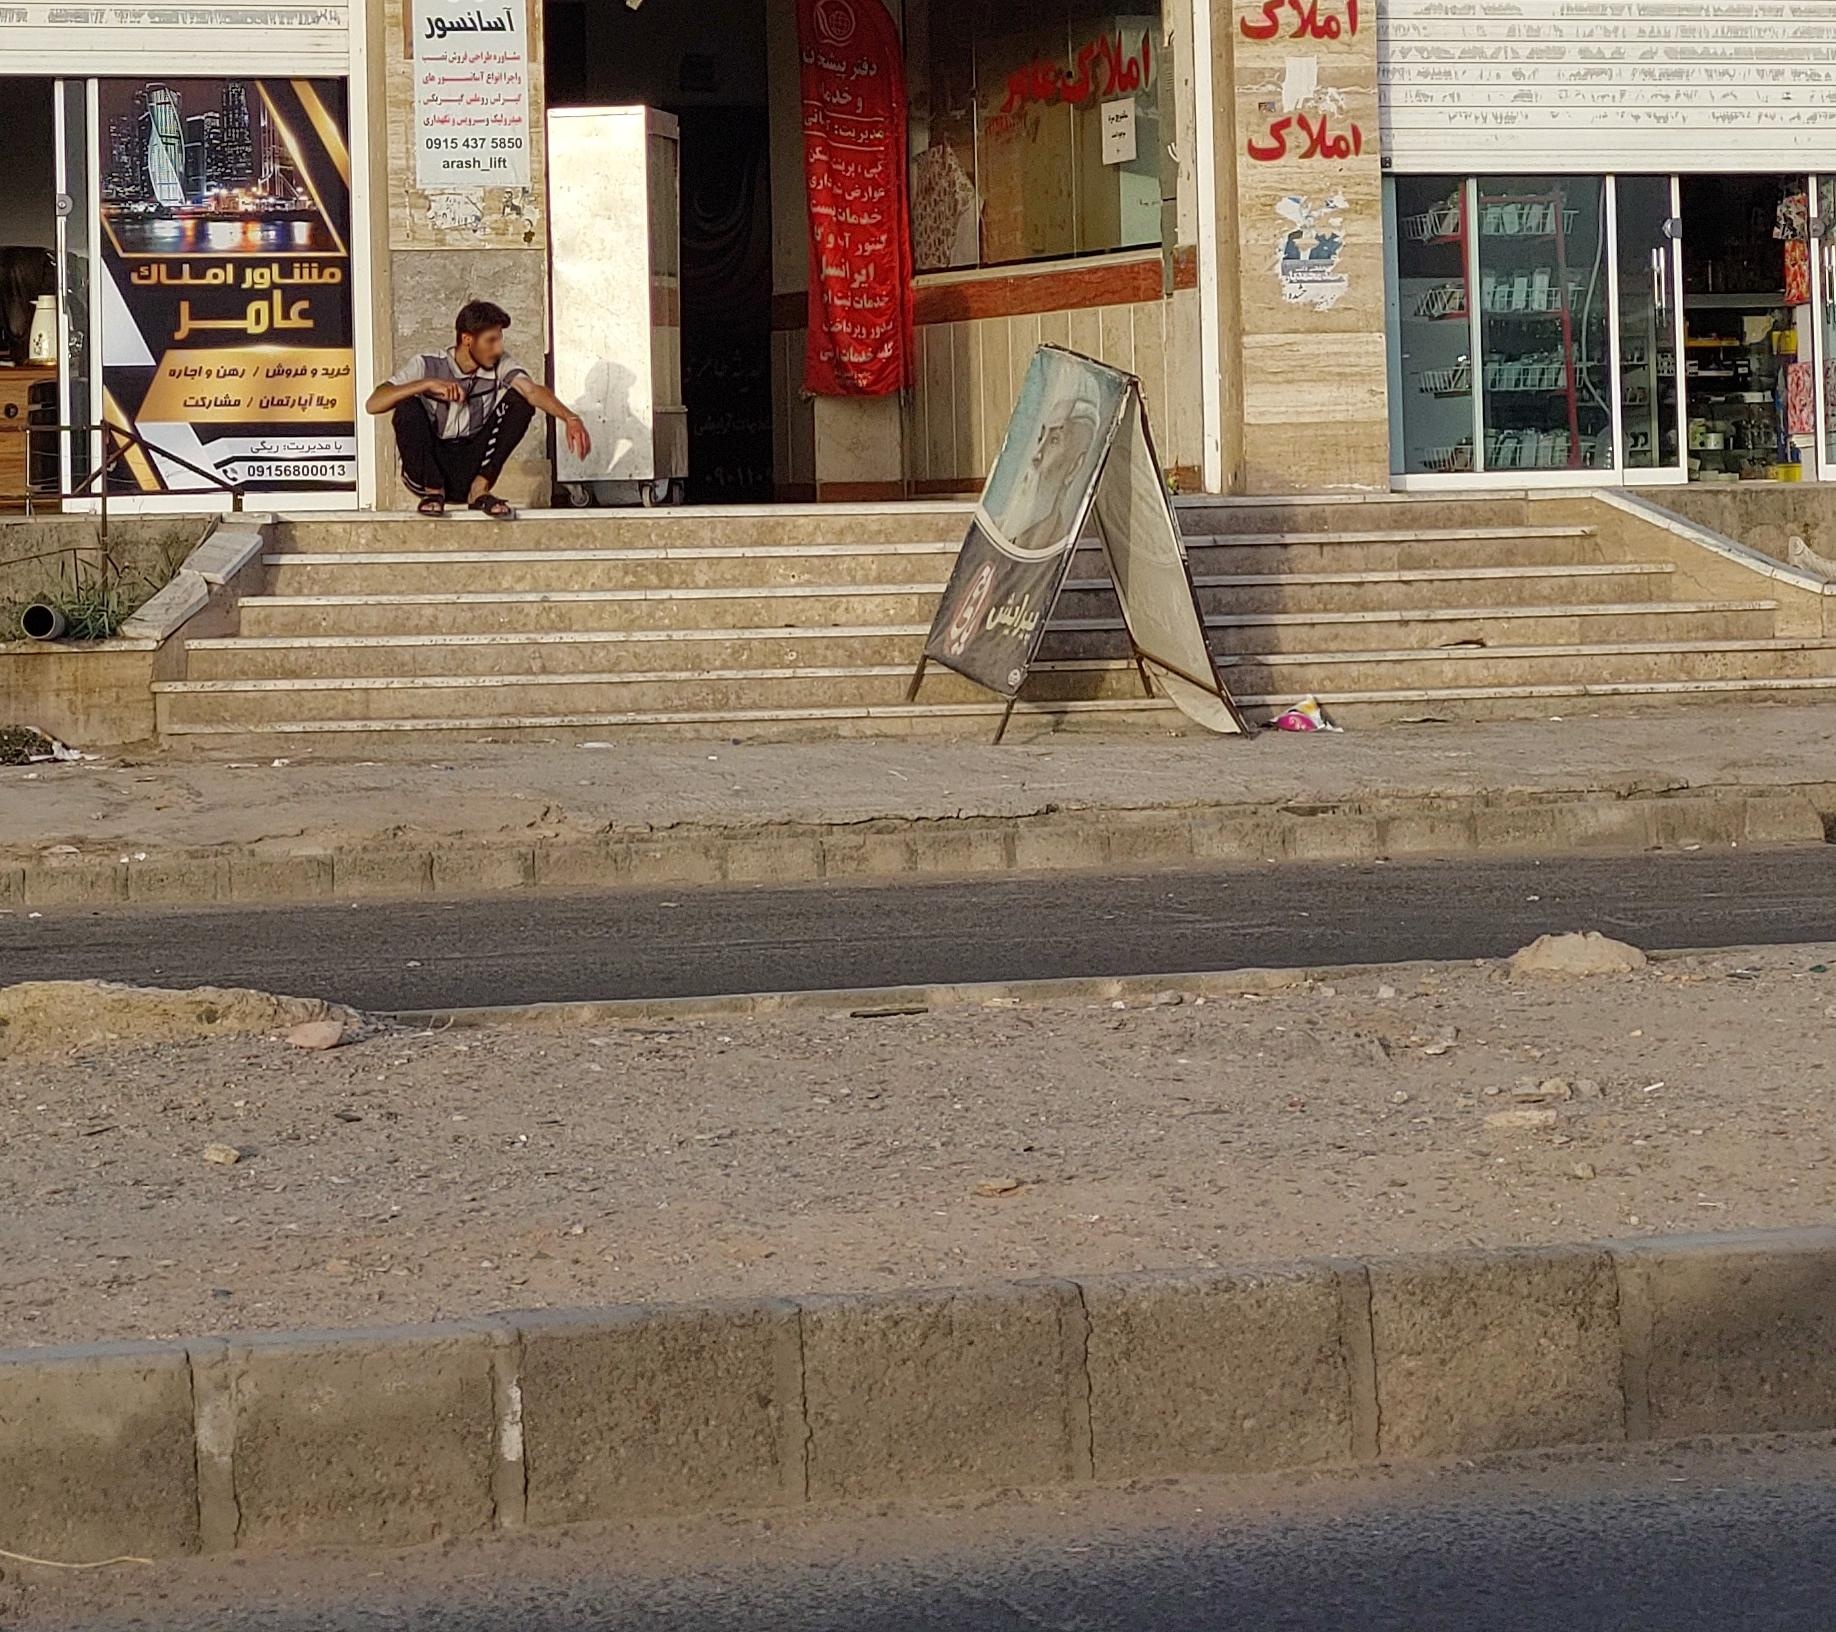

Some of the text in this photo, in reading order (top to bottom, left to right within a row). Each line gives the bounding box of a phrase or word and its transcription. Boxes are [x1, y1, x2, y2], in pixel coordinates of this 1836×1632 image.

[424, 6, 515, 39] آسانسور
[850, 56, 877, 80] دفتر
[1060, 26, 1150, 104] املاک
[486, 72, 503, 85] انواع
[425, 137, 523, 149] 0915 437 5850
[1247, 112, 1362, 162] املاک
[442, 157, 507, 172] arash_lift
[844, 185, 885, 202] عوارض
[854, 233, 888, 256] کنتور
[130, 262, 342, 289] مشاور املاک
[853, 290, 890, 309] خدمات
[173, 289, 314, 341] عامر
[168, 365, 202, 379] اجاره
[205, 369, 213, 379] و
[216, 365, 246, 379] رهن
[265, 363, 307, 379] فروش
[310, 369, 318, 378] و
[321, 364, 351, 378] خرید
[183, 393, 242, 409] مشارکت
[258, 393, 313, 412] آپارتمان
[315, 396, 337, 409] ویلا
[250, 441, 280, 454] ریگی
[333, 441, 343, 451] با
[247, 464, 346, 477] 09156800013
